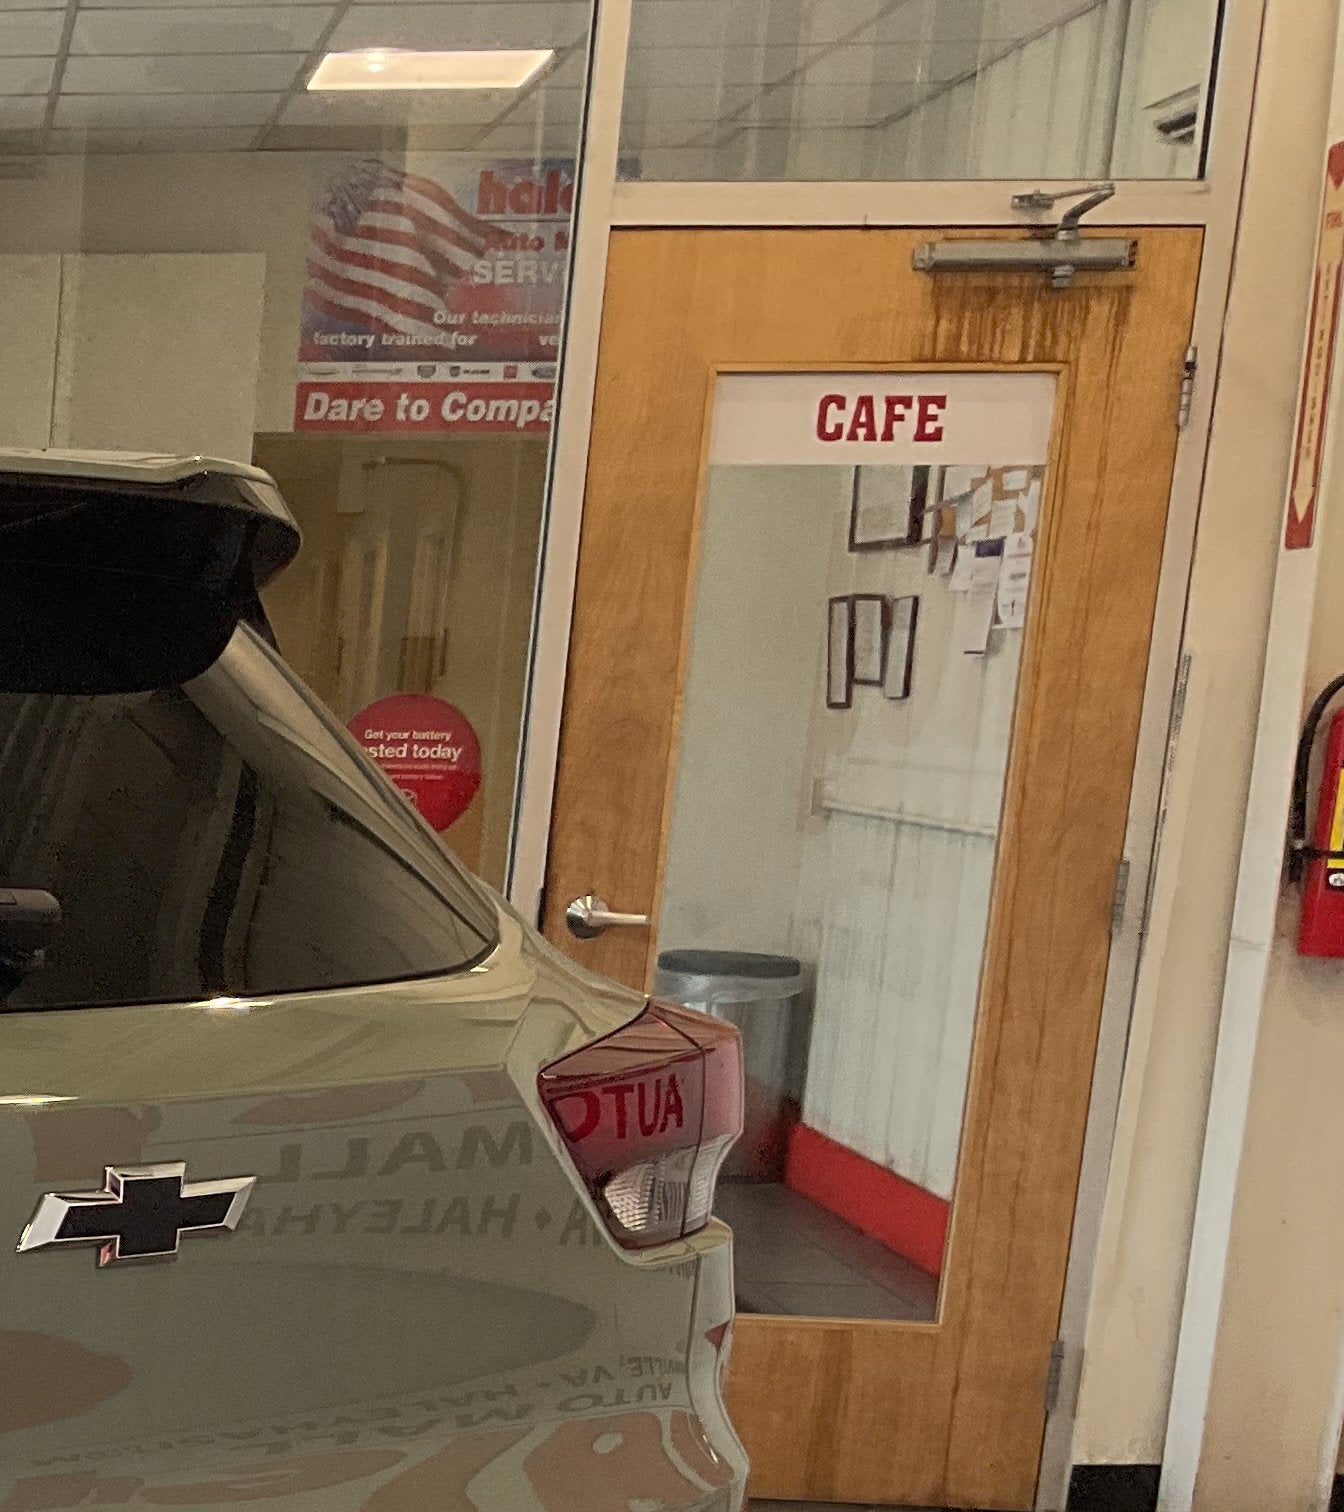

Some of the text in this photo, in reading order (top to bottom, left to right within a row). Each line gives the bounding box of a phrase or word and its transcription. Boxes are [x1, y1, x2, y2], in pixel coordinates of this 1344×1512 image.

[472, 259, 569, 284] SERV
[433, 311, 465, 325] Our
[313, 332, 376, 348] factory
[381, 333, 447, 346] trained
[450, 331, 478, 350] for
[303, 392, 385, 421] Dare
[395, 393, 430, 421] to
[815, 394, 947, 442] CAFE
[364, 728, 453, 743] Get your battery
[362, 743, 464, 763] sted today
